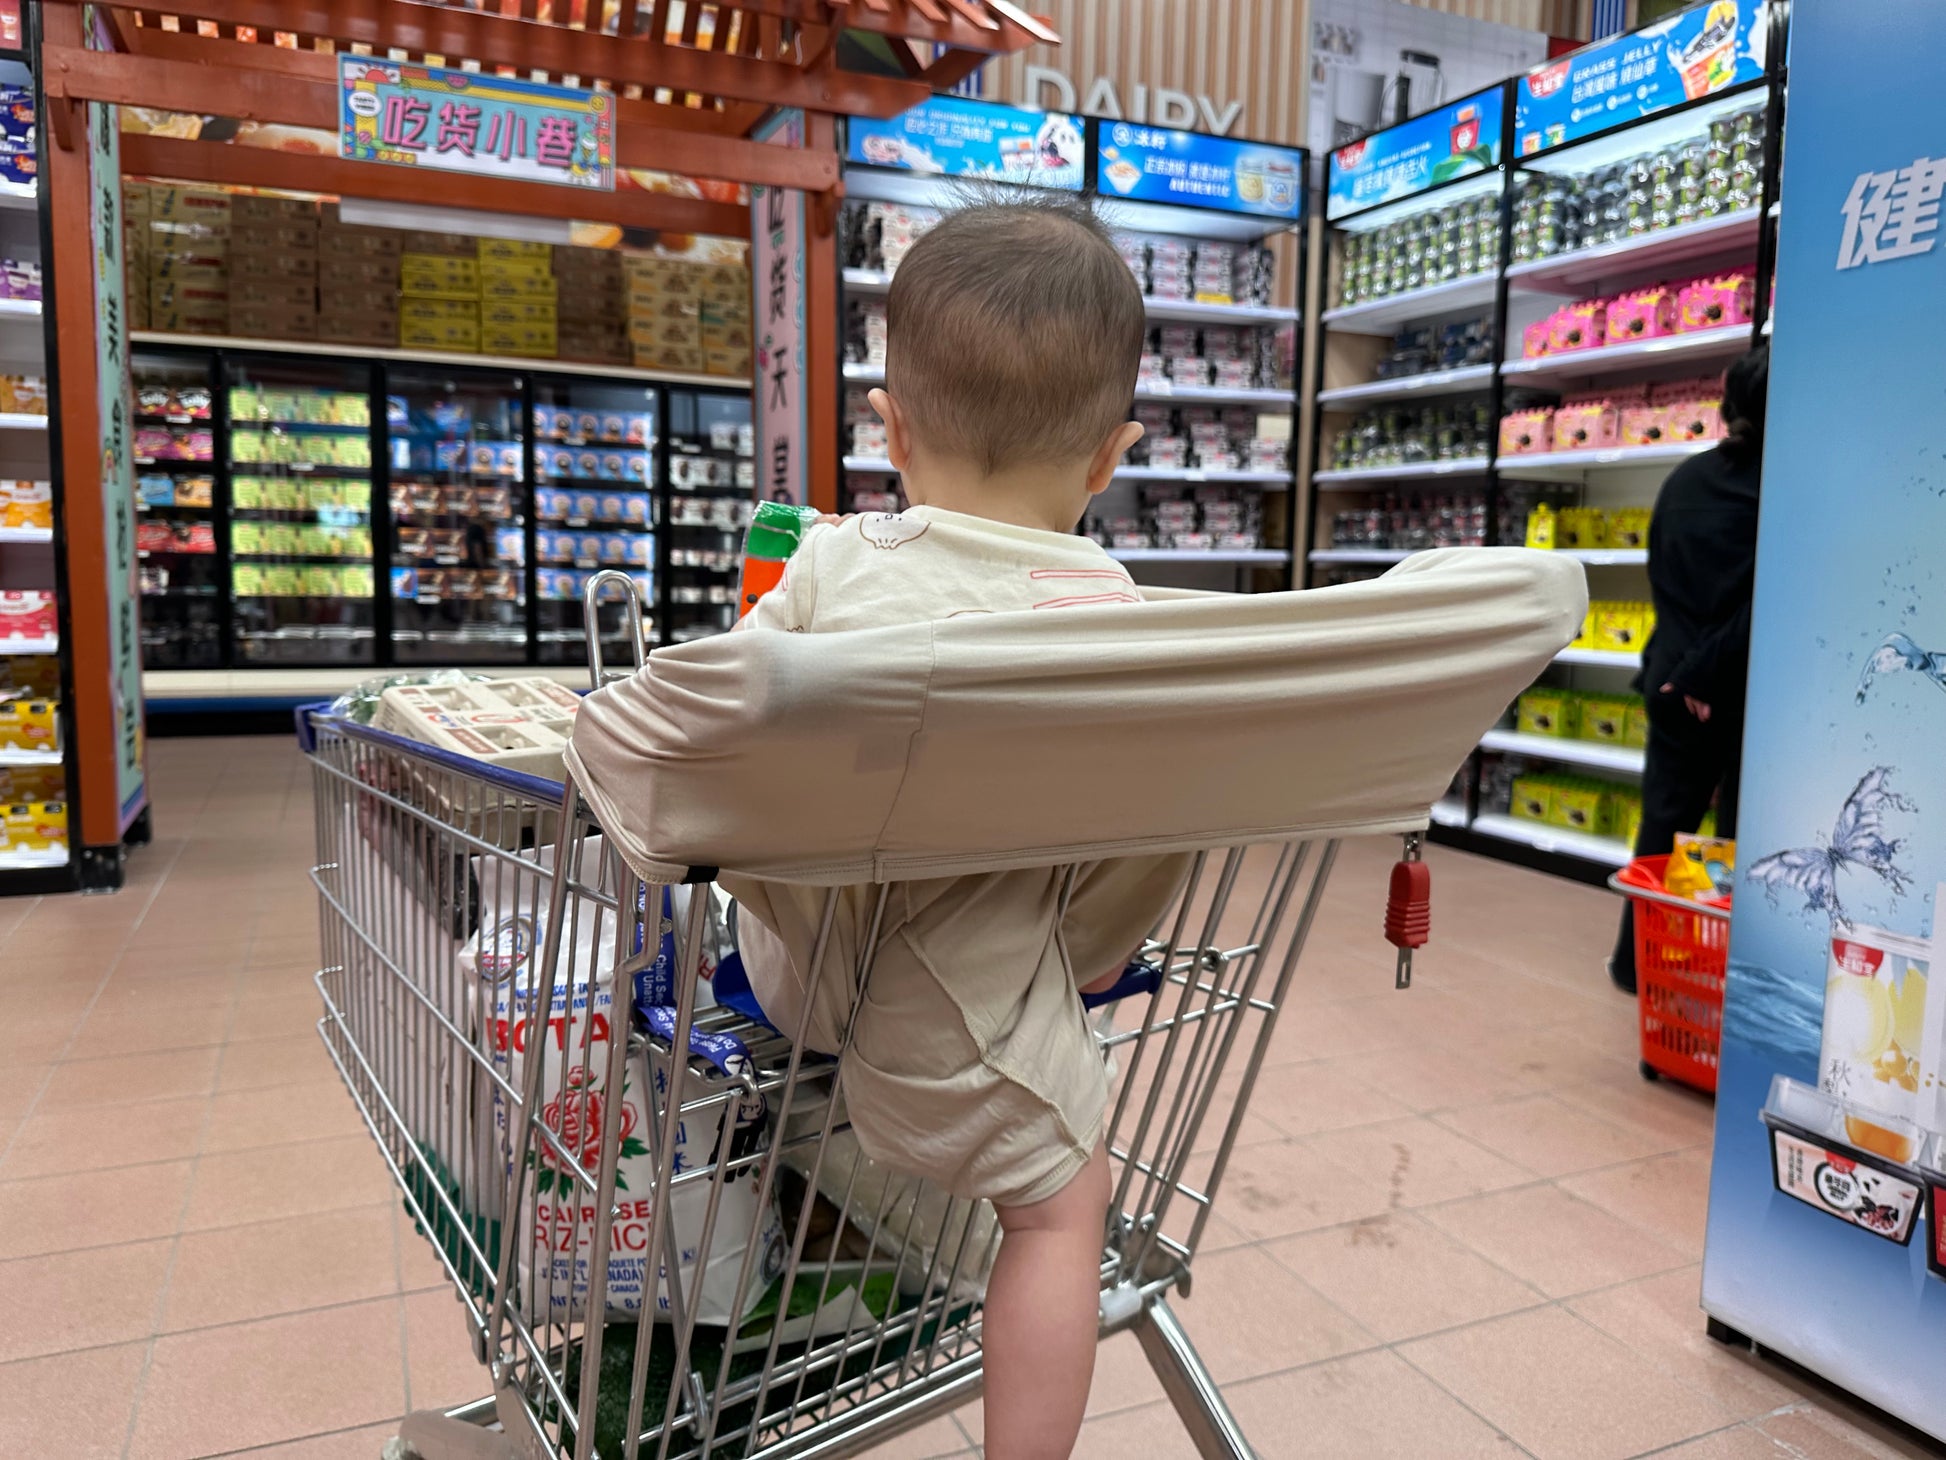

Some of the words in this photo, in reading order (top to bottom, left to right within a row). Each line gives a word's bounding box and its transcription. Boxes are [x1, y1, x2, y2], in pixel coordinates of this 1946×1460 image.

[1622, 38, 1663, 64] JELLY
[383, 96, 577, 167] 吃货小巷
[1836, 157, 1946, 270] 健
[656, 954, 667, 982] Child
[486, 1012, 613, 1053] BOTA
